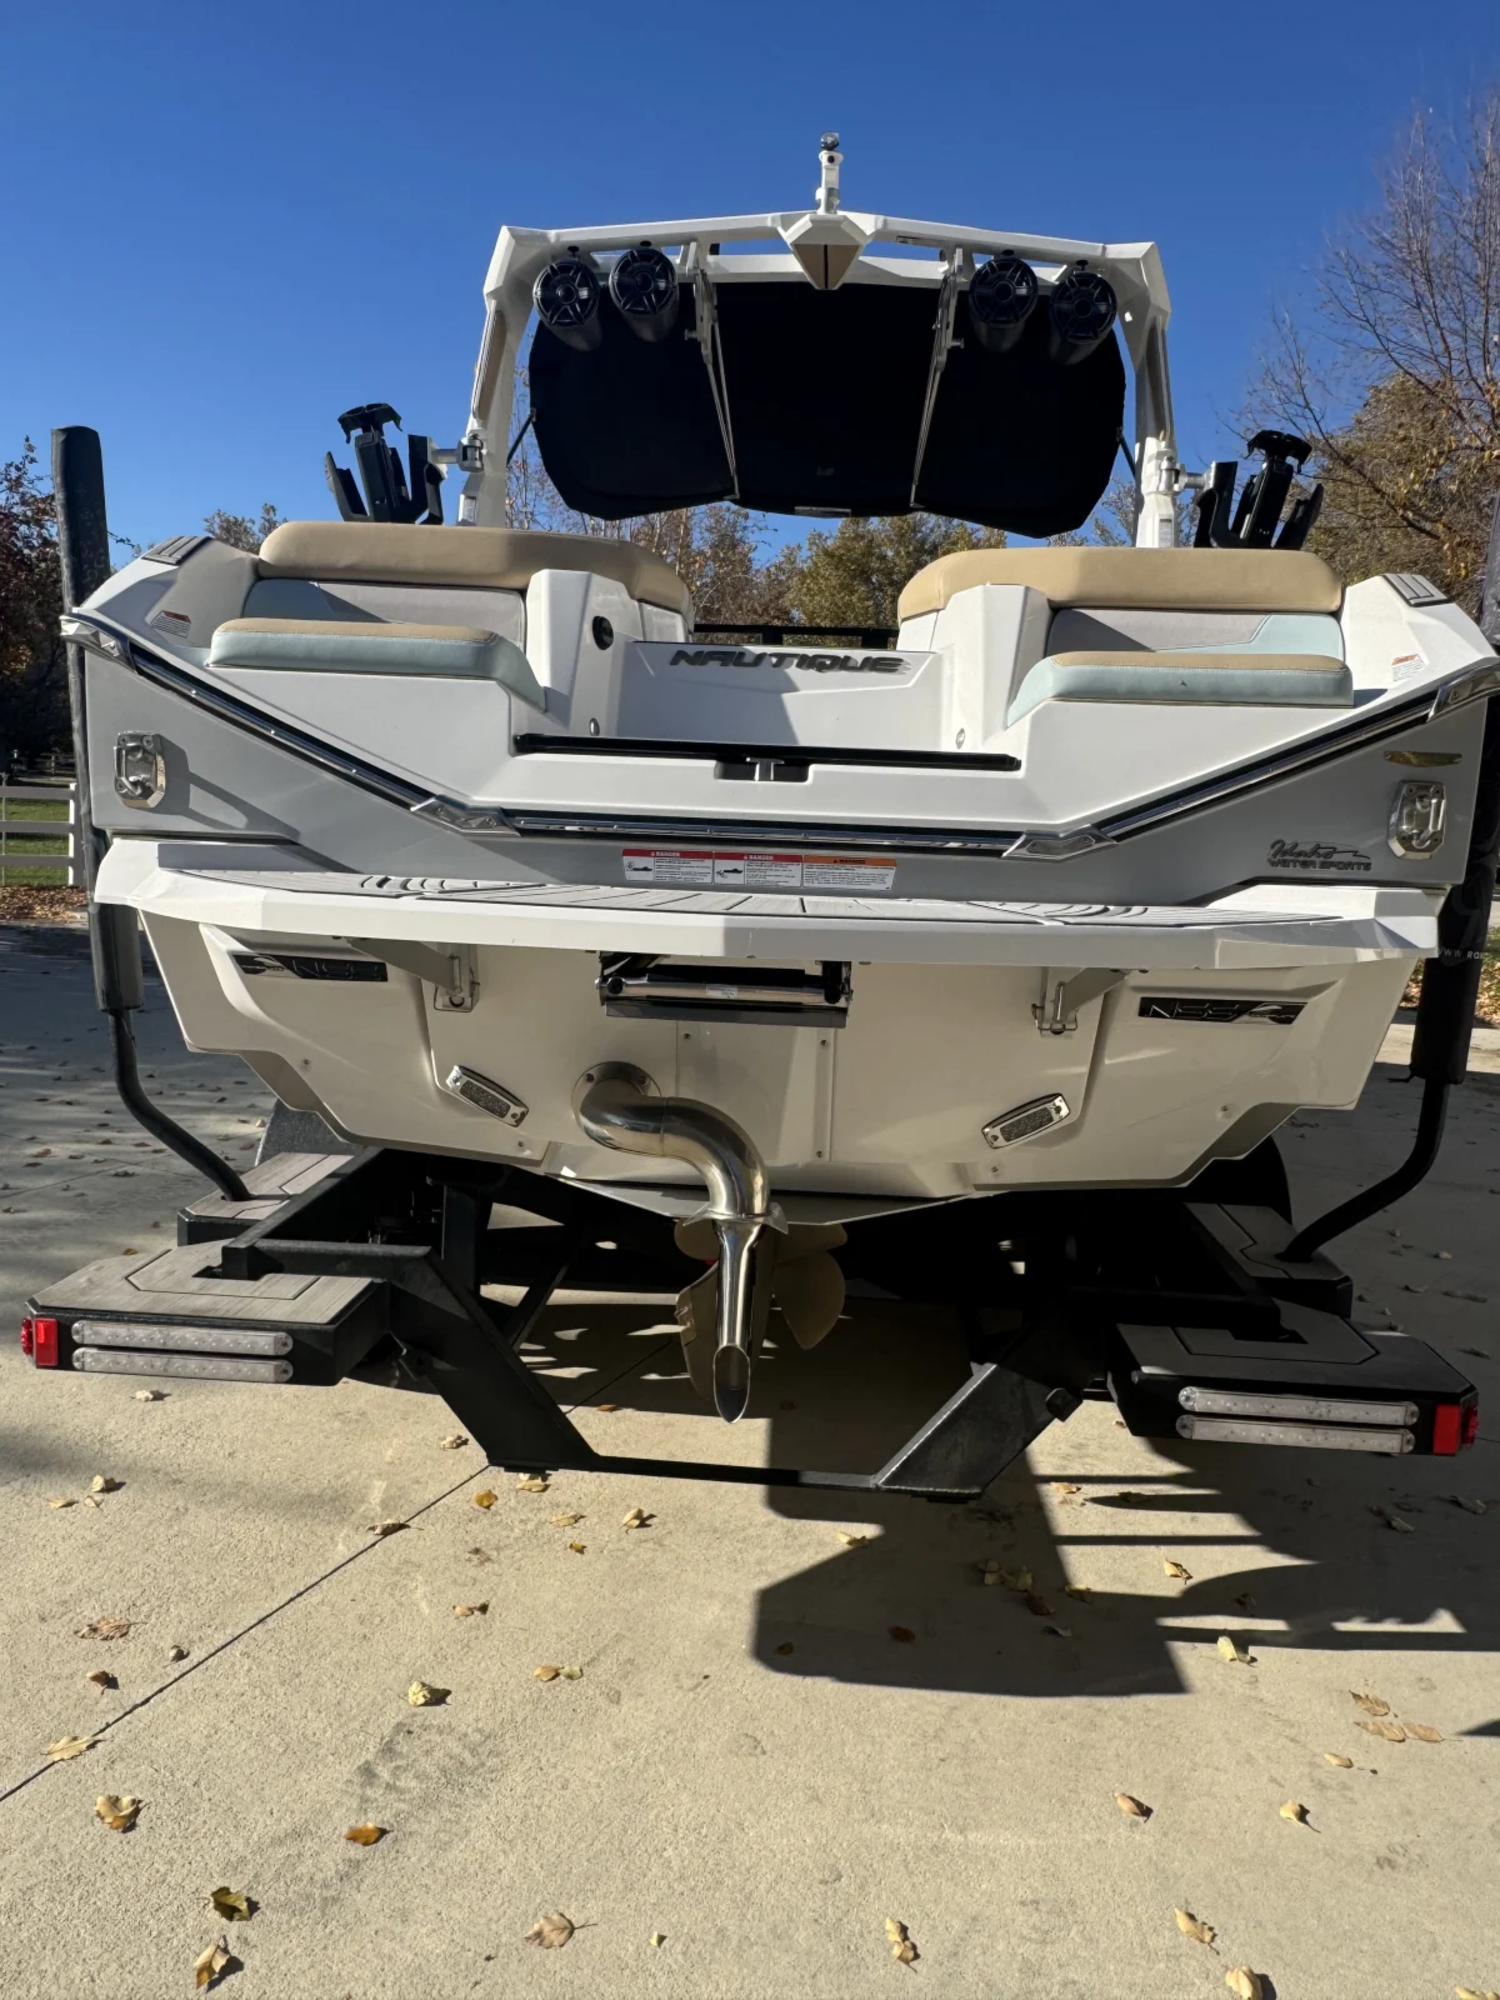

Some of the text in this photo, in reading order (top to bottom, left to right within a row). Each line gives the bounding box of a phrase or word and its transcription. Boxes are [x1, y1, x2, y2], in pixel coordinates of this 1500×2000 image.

[669, 649, 911, 676] NAUTIQUE
[1268, 838, 1337, 859] Idaho
[1267, 858, 1372, 872] WATER SPORTS
